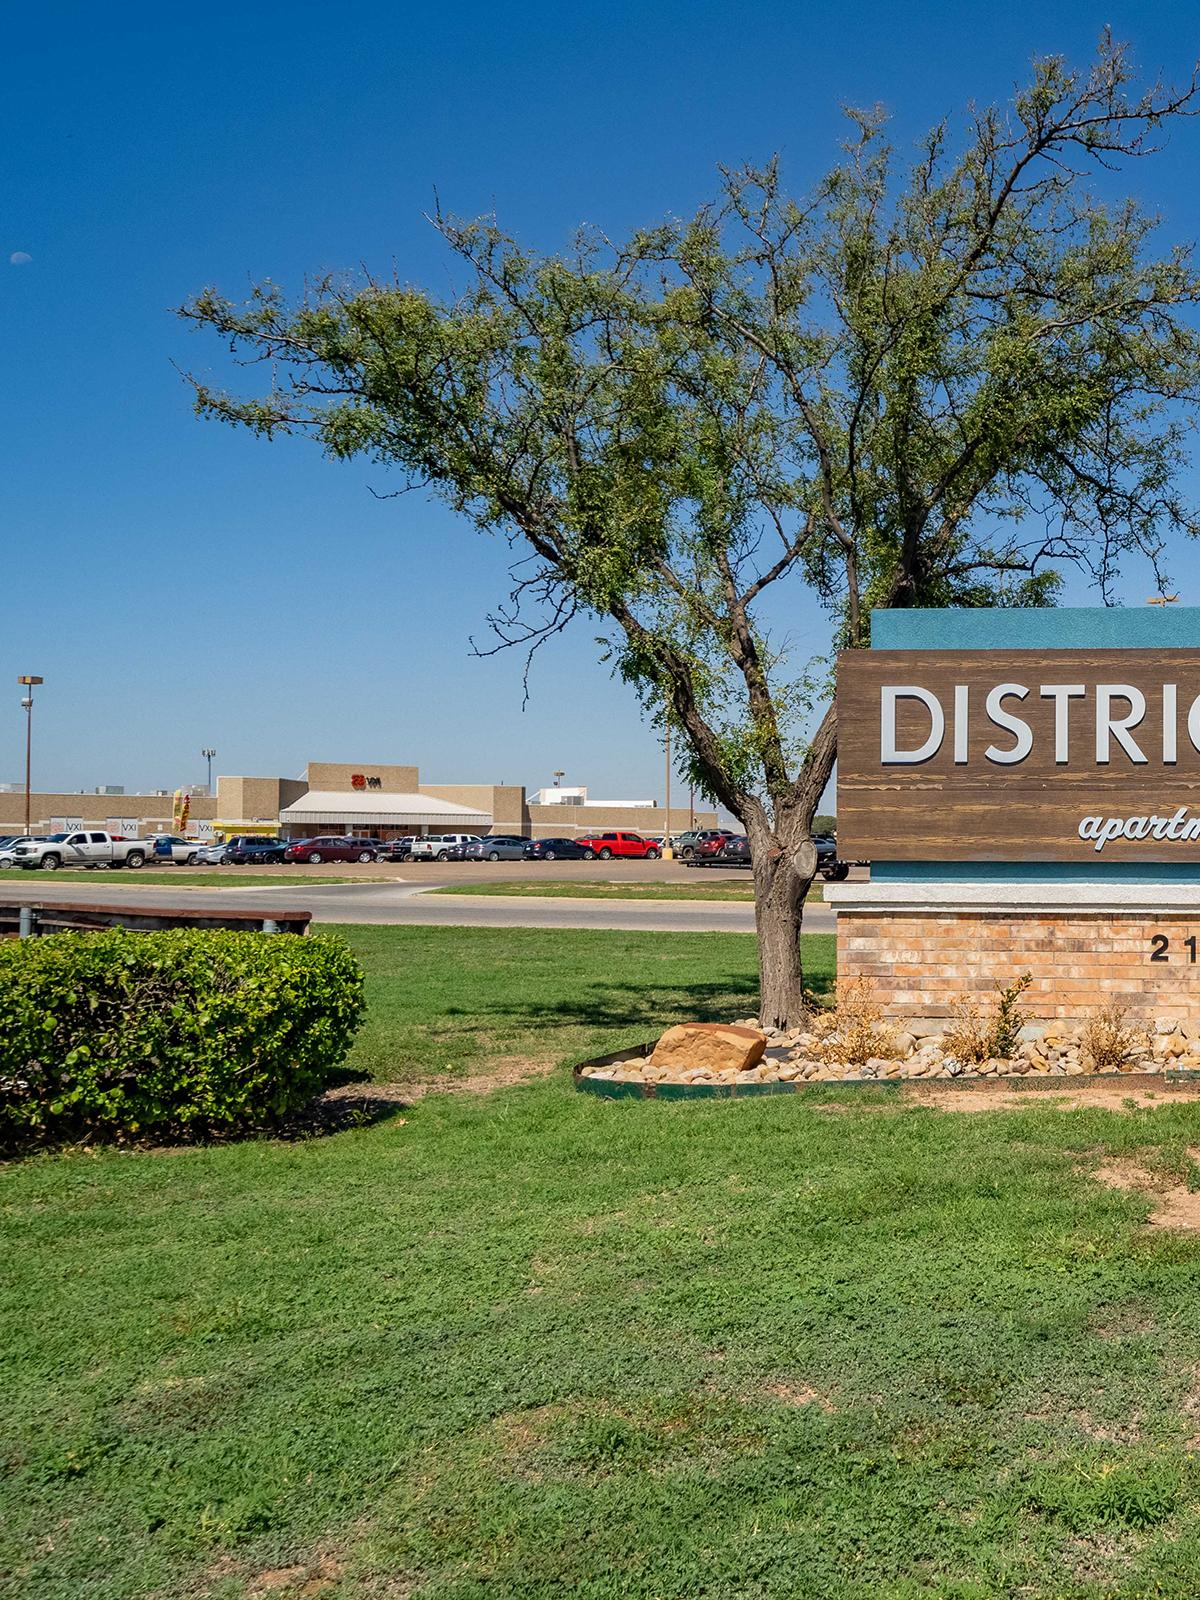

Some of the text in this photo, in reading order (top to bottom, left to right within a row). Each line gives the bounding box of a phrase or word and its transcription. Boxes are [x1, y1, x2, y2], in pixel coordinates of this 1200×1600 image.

[67, 823, 82, 831] VXI
[122, 823, 137, 831] VXI
[199, 823, 213, 832] VXI
